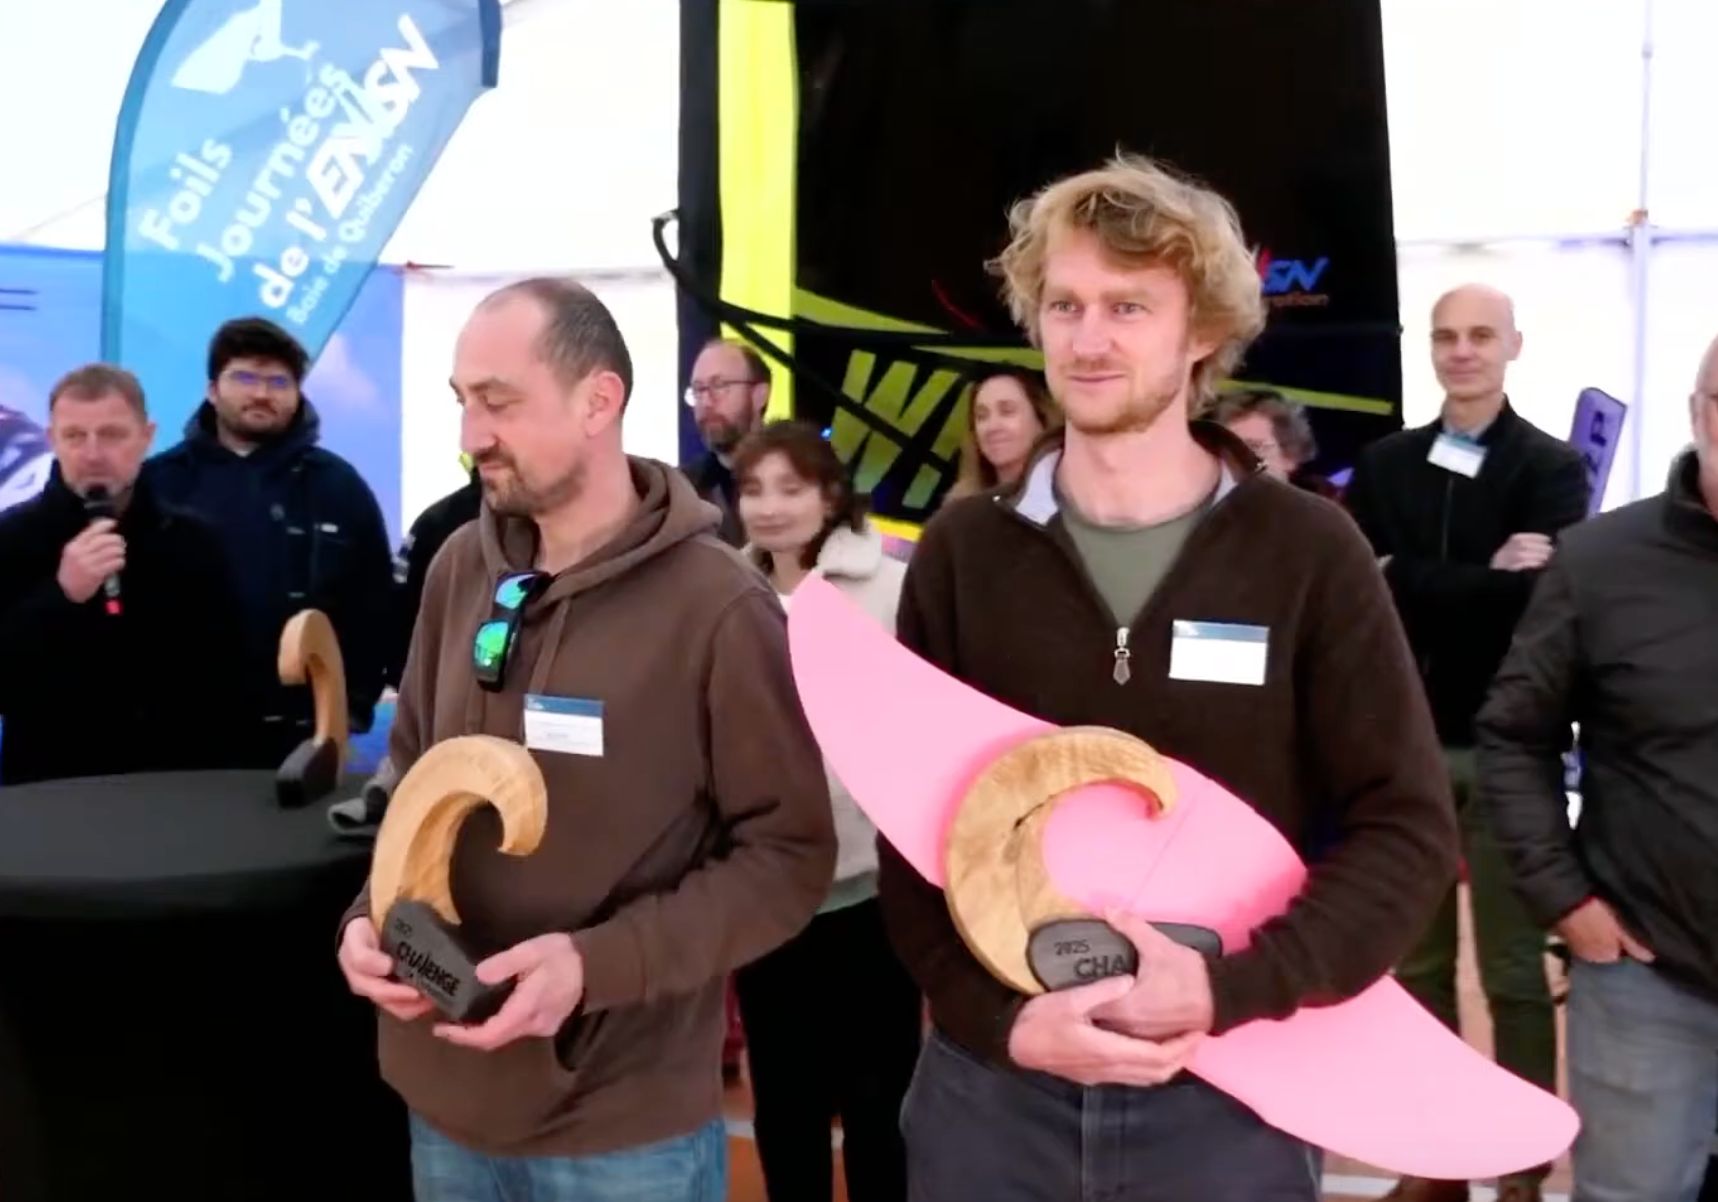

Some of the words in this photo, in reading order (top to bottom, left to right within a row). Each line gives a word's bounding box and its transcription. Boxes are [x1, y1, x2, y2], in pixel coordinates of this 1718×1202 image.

[139, 138, 232, 250] Foils
[196, 63, 350, 283] Journées
[253, 246, 309, 308] de
[286, 276, 328, 323] Baie
[321, 246, 347, 274] de
[338, 144, 413, 242] Quiberon
[1054, 938, 1090, 956] 2025
